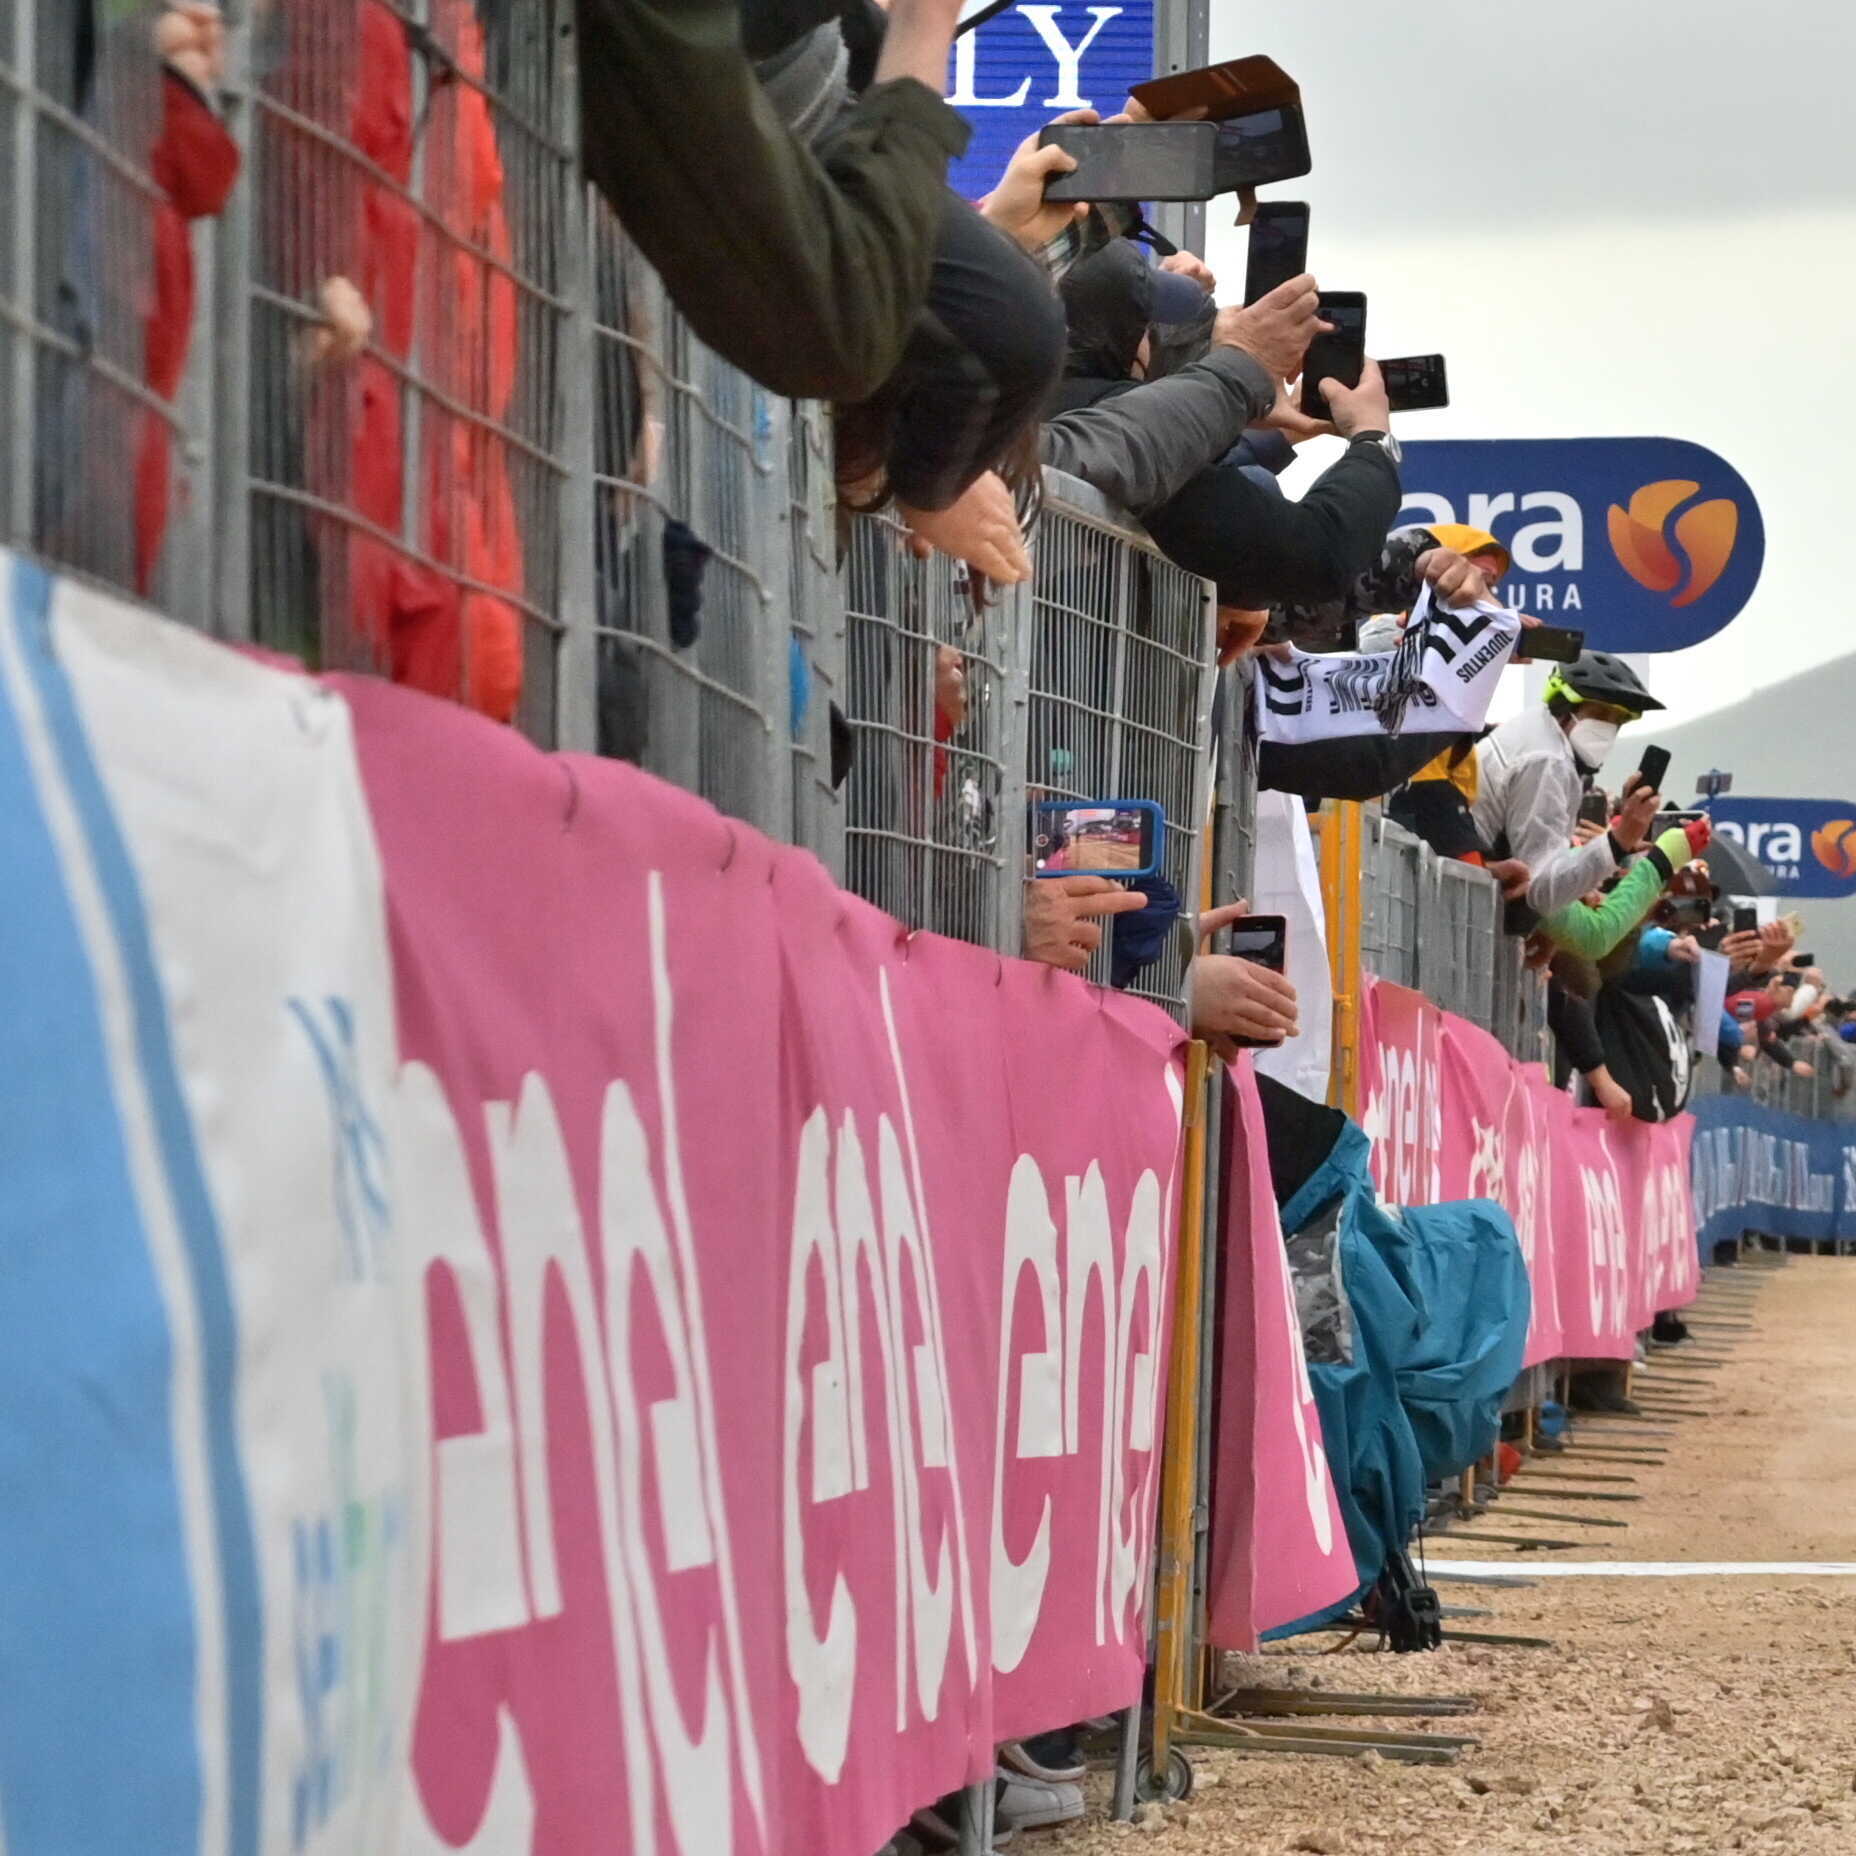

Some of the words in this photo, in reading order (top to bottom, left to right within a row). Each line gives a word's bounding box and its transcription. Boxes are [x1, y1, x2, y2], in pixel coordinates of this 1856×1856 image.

[1456, 630, 1515, 684] JUVENTUS
[785, 965, 978, 1785] enel
[991, 1060, 1183, 1675] enel
